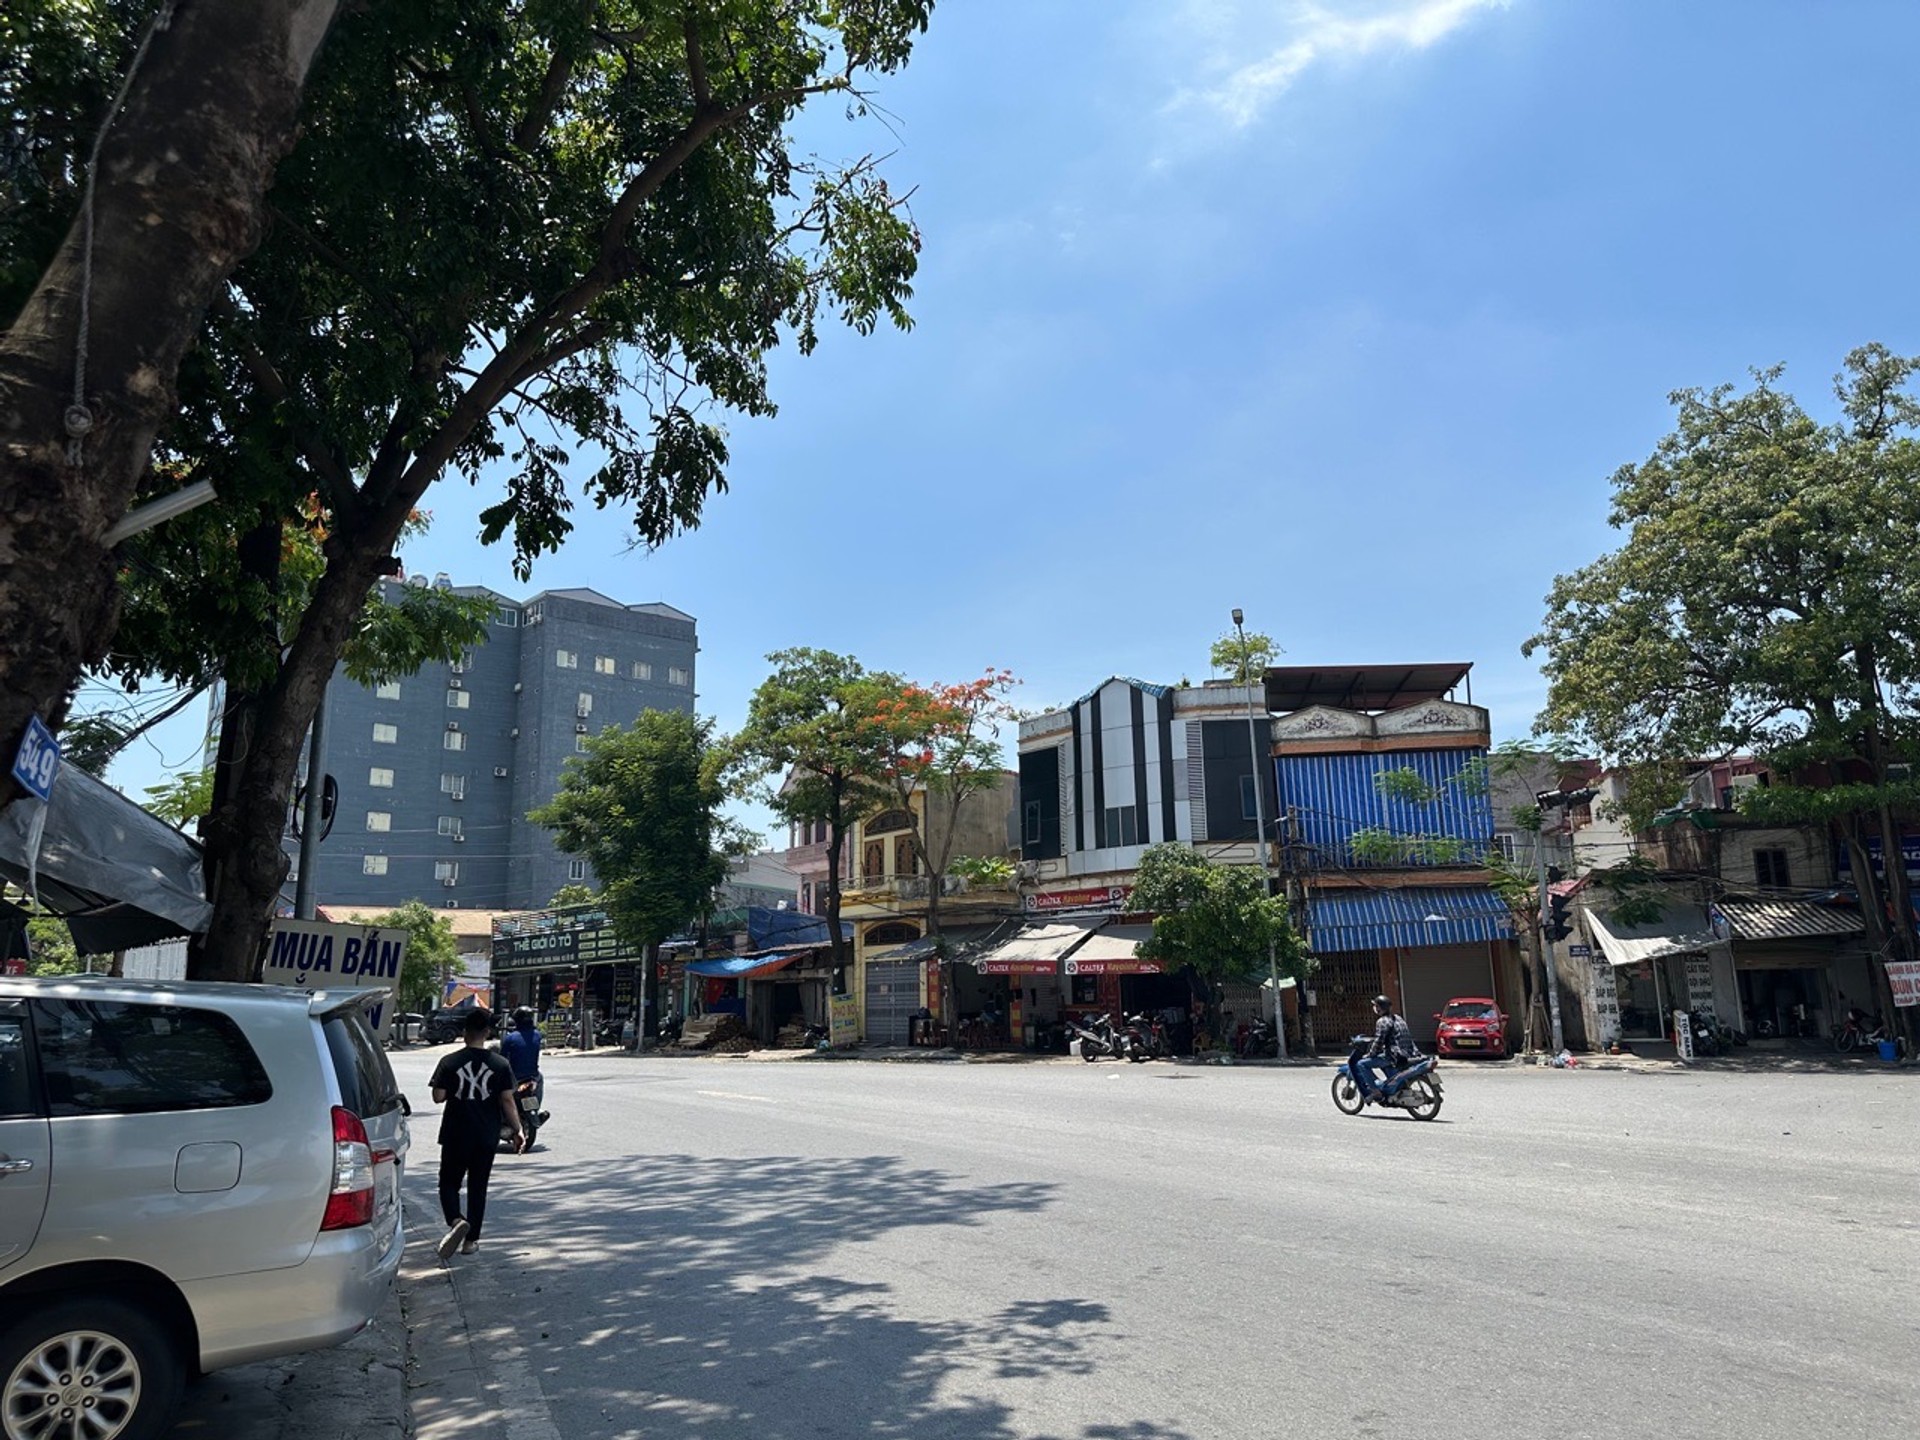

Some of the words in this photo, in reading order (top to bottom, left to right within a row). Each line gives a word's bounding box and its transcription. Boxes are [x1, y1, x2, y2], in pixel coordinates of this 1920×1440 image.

[20, 727, 55, 789] 549
[270, 931, 334, 972] MUA
[549, 934, 557, 948] Ô
[559, 933, 572, 947] TÔ
[988, 964, 1009, 972] CALTEX
[1080, 963, 1104, 973] CALTEX
[1107, 961, 1138, 971] Havoline
[455, 1060, 494, 1101] NY
